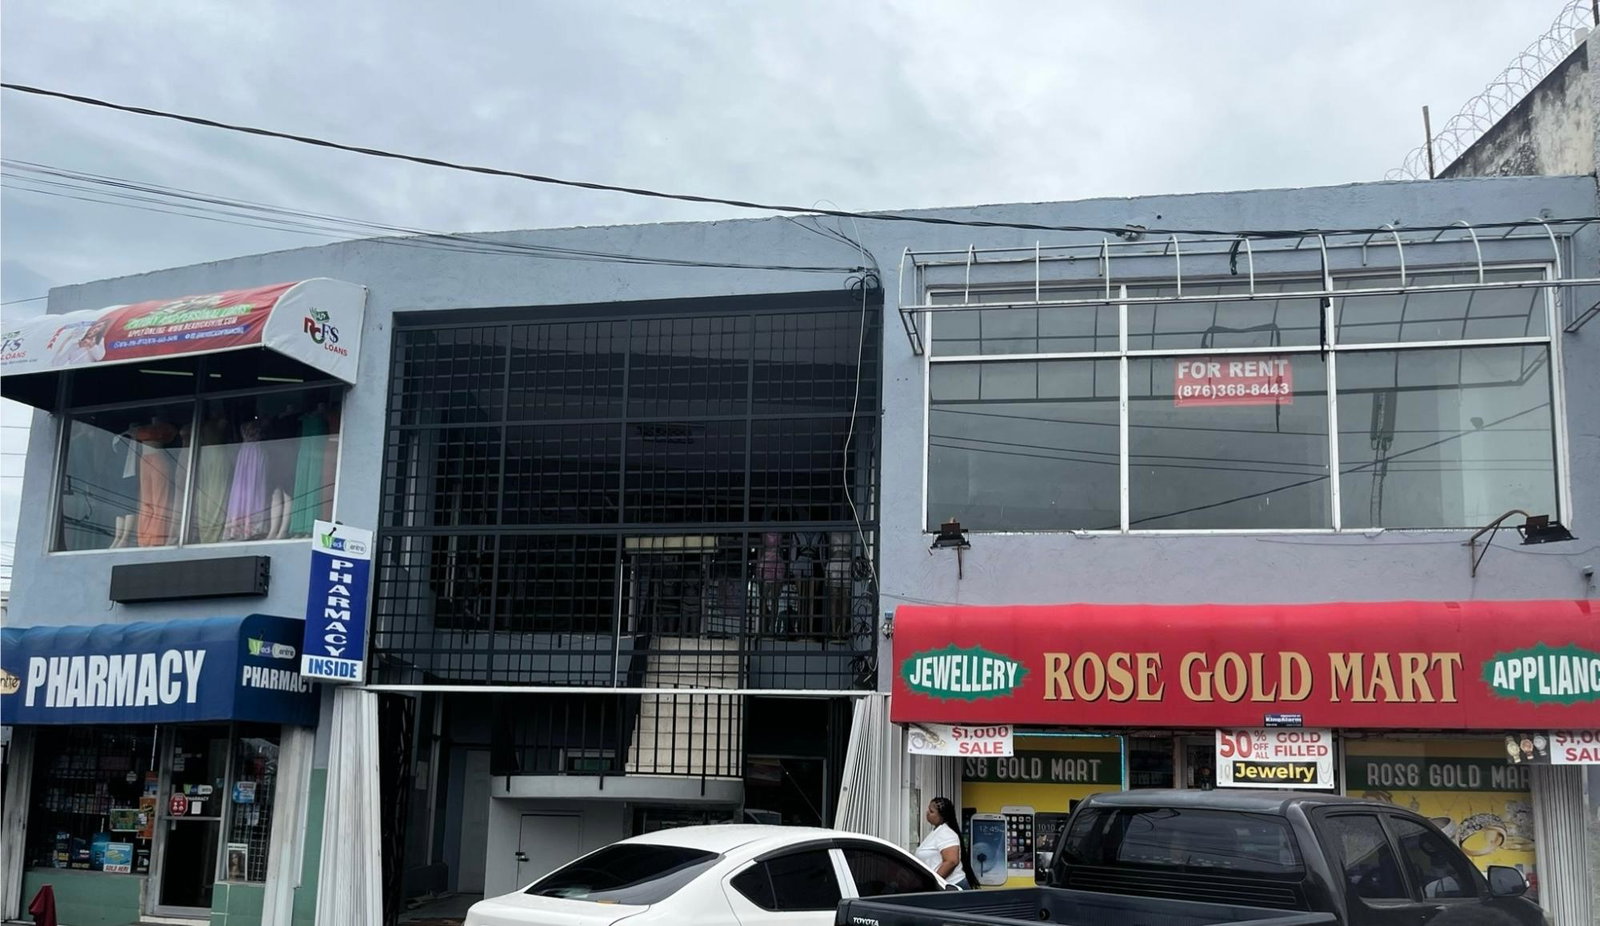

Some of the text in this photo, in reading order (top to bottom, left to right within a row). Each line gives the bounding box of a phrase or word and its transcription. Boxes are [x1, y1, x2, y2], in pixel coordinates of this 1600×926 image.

[324, 342, 348, 357] LOANS
[1178, 359, 1288, 379] FOR RENT
[1178, 382, 1290, 400] (876)368-8443
[324, 559, 354, 657] PHARMACY
[308, 657, 357, 679] INSIDE
[909, 654, 1018, 692] JEWELLERY
[1043, 651, 1464, 703] ROSE GOLD MART
[1492, 654, 1600, 695] APPLIANC
[24, 649, 206, 708] PHARMACY
[951, 725, 1009, 741] $1,000
[1276, 731, 1321, 744] GOLD
[959, 741, 1004, 755] SALE
[1219, 730, 1253, 759] 50
[1253, 742, 1269, 751] OFF
[1274, 744, 1329, 757] FILLED
[1254, 751, 1269, 760] ALL
[996, 757, 1042, 780] GOLD
[1050, 758, 1102, 783] MART
[1234, 762, 1316, 783] Jewelry
[1429, 763, 1481, 788] GOLD
[853, 916, 880, 926] TOYOTA
